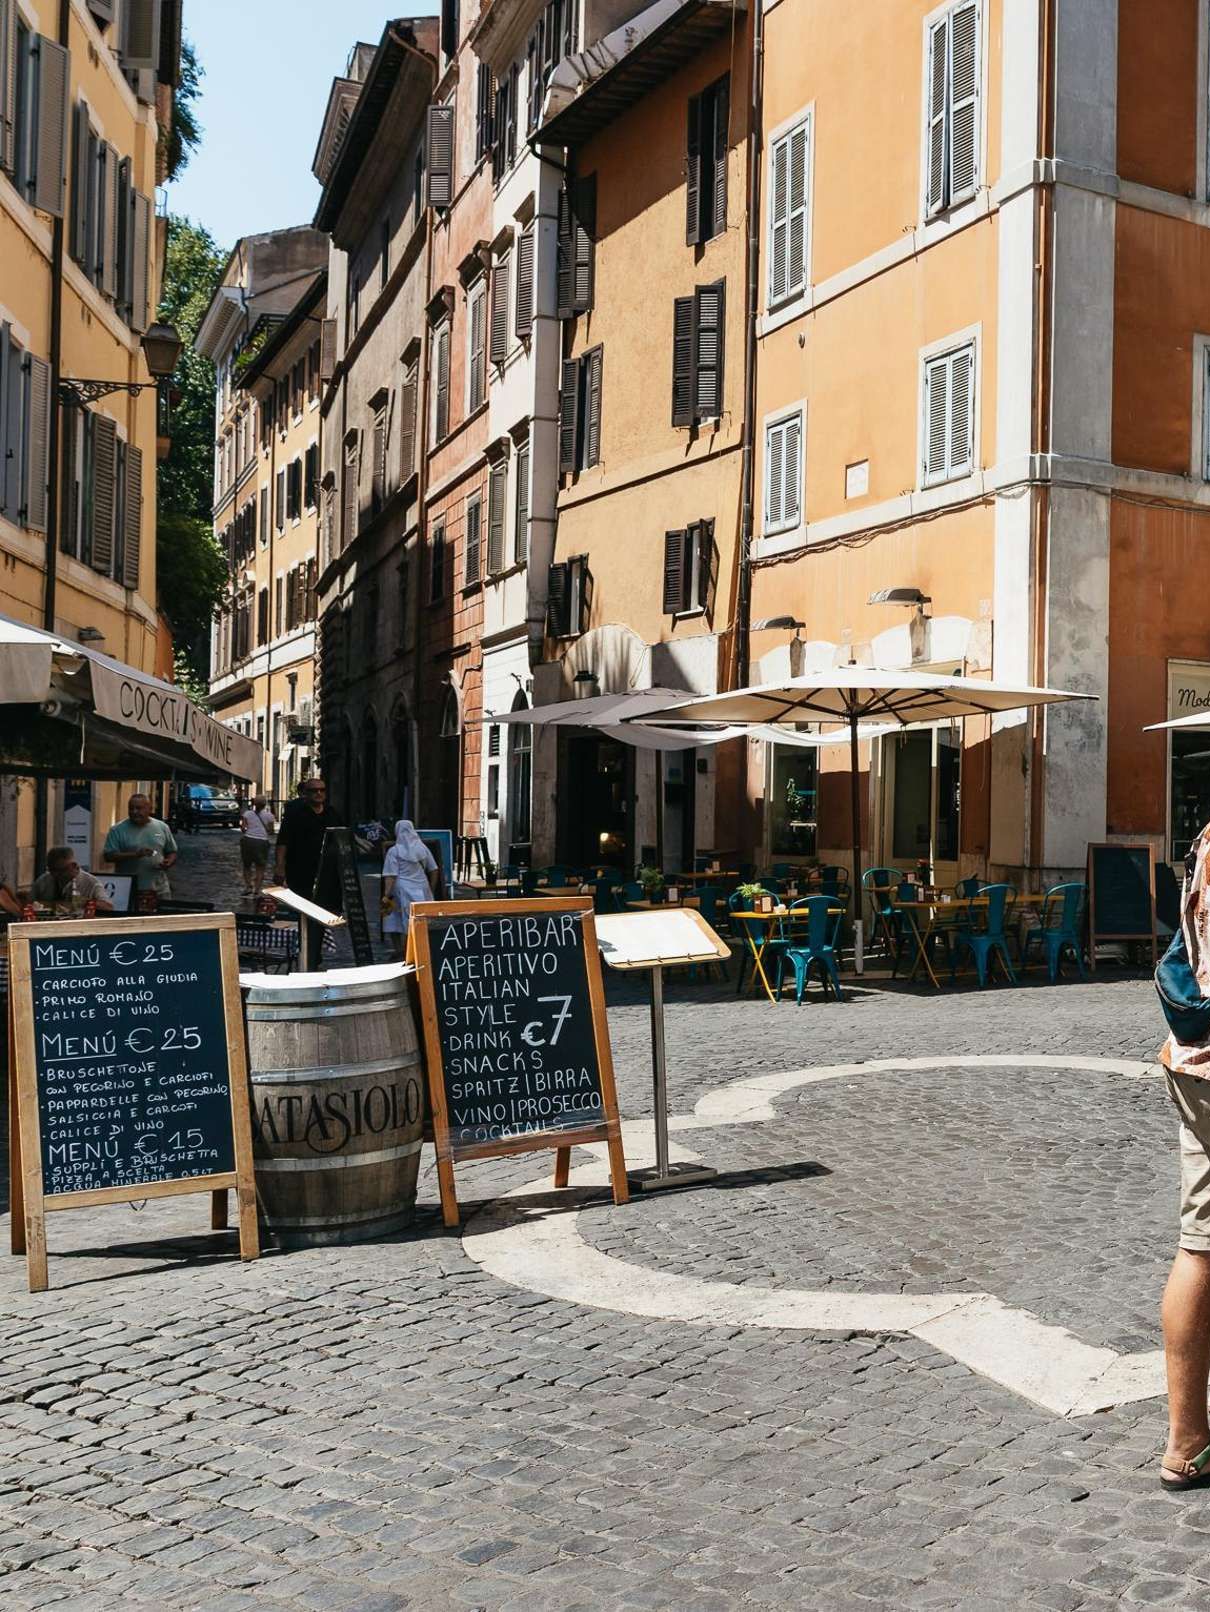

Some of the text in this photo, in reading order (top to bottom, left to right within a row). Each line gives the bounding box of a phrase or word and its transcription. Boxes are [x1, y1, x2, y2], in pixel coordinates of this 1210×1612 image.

[440, 914, 577, 950] APERIBAR
[438, 952, 558, 981] APERITIVO
[42, 972, 198, 991] CARCIOFO ALLA GIUDIA
[442, 978, 530, 1001] ITALIAN
[42, 990, 154, 1007] PRIMO ROMANO
[42, 1004, 160, 1021] CALICE DI VINO
[444, 1003, 518, 1026] STYLE
[450, 1030, 512, 1052] DRINK
[46, 1061, 158, 1081] BRUSCHETTONE
[450, 1050, 543, 1076] SNACKS
[73, 1080, 135, 1094] PECORINO
[144, 1077, 152, 1087] E
[159, 1071, 214, 1086] CARCIOFI
[48, 1094, 139, 1112] PAPPARDELLE
[48, 1109, 121, 1125] SALSICCIA
[130, 1107, 138, 1118] E
[252, 1078, 420, 1154] ATASIOLO
[50, 1121, 165, 1140] CALICE DI VINO
[115, 1159, 124, 1168] E
[51, 1165, 166, 1185] PIZZA A SCELTA
[53, 1181, 101, 1195] ACQUA
